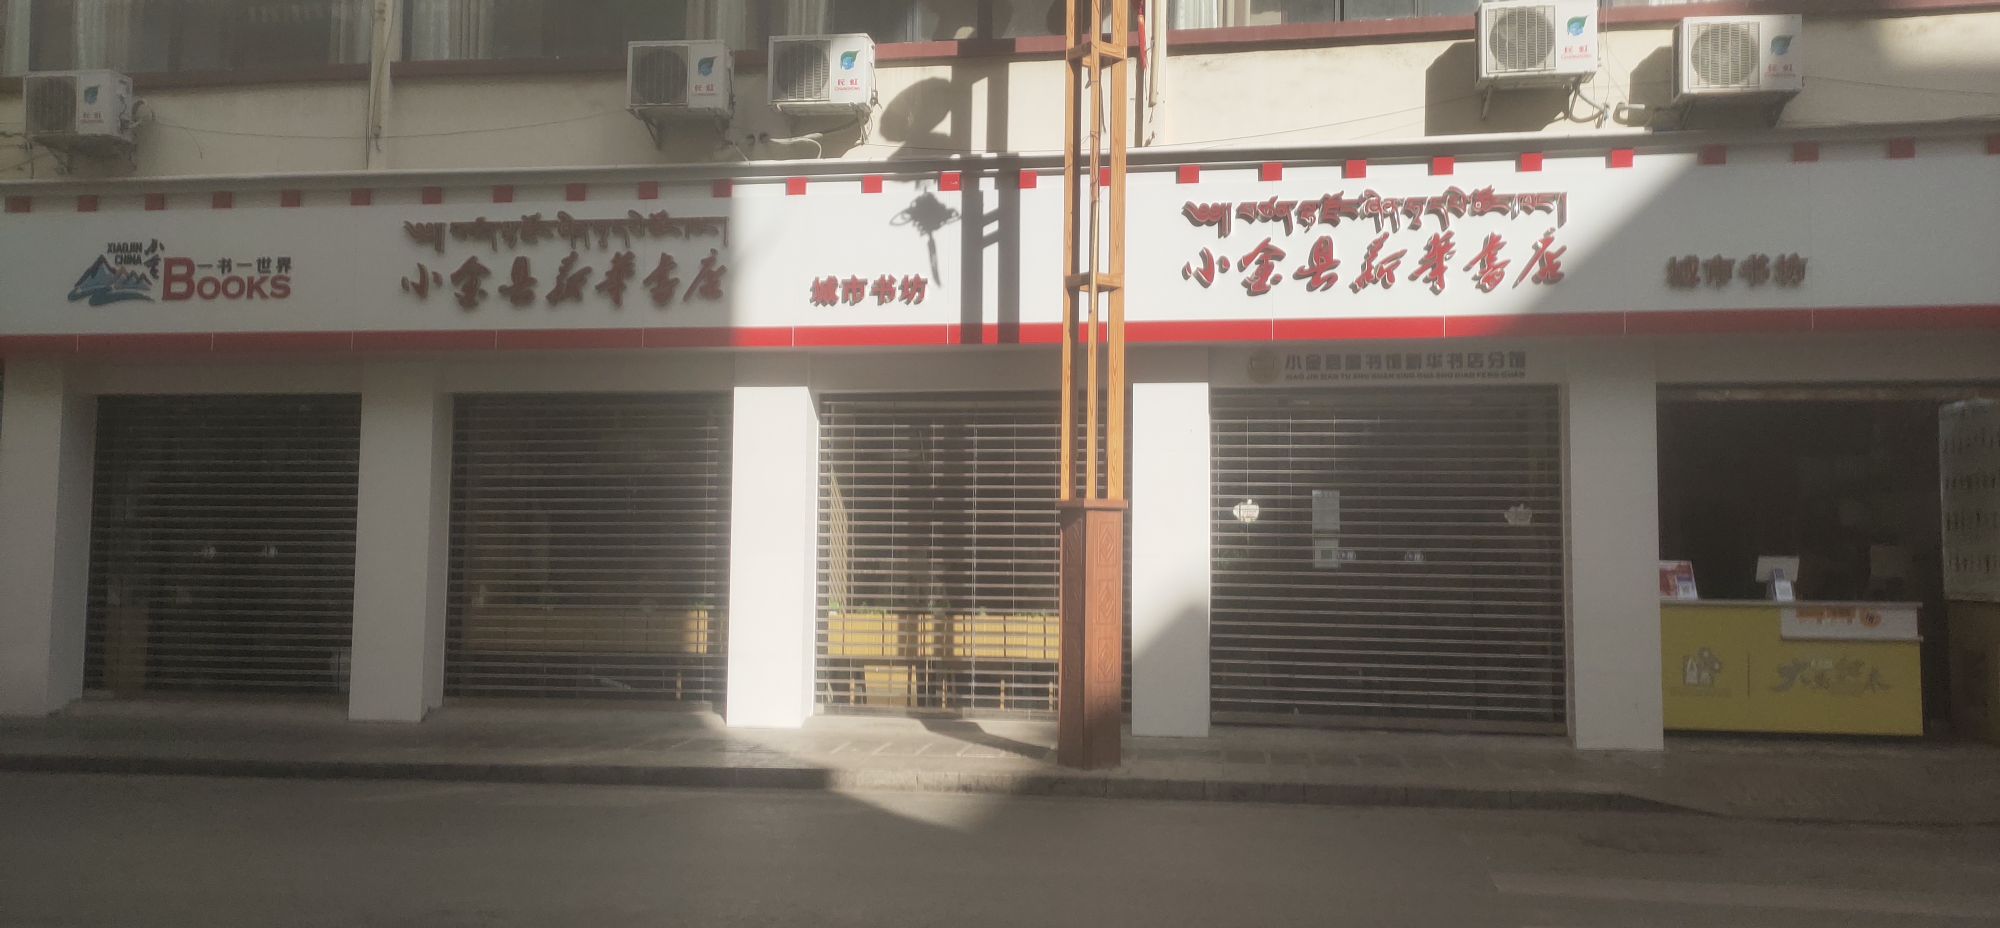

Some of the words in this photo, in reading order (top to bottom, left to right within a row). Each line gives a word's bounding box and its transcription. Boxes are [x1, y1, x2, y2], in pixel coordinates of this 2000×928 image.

[107, 241, 143, 253] XIAOJIN
[114, 253, 143, 265] CHINA
[197, 256, 292, 274] 一书一世界
[1666, 252, 1807, 288] 城市书坊
[163, 256, 292, 301] BOOKS
[809, 272, 929, 307] 城市书坊
